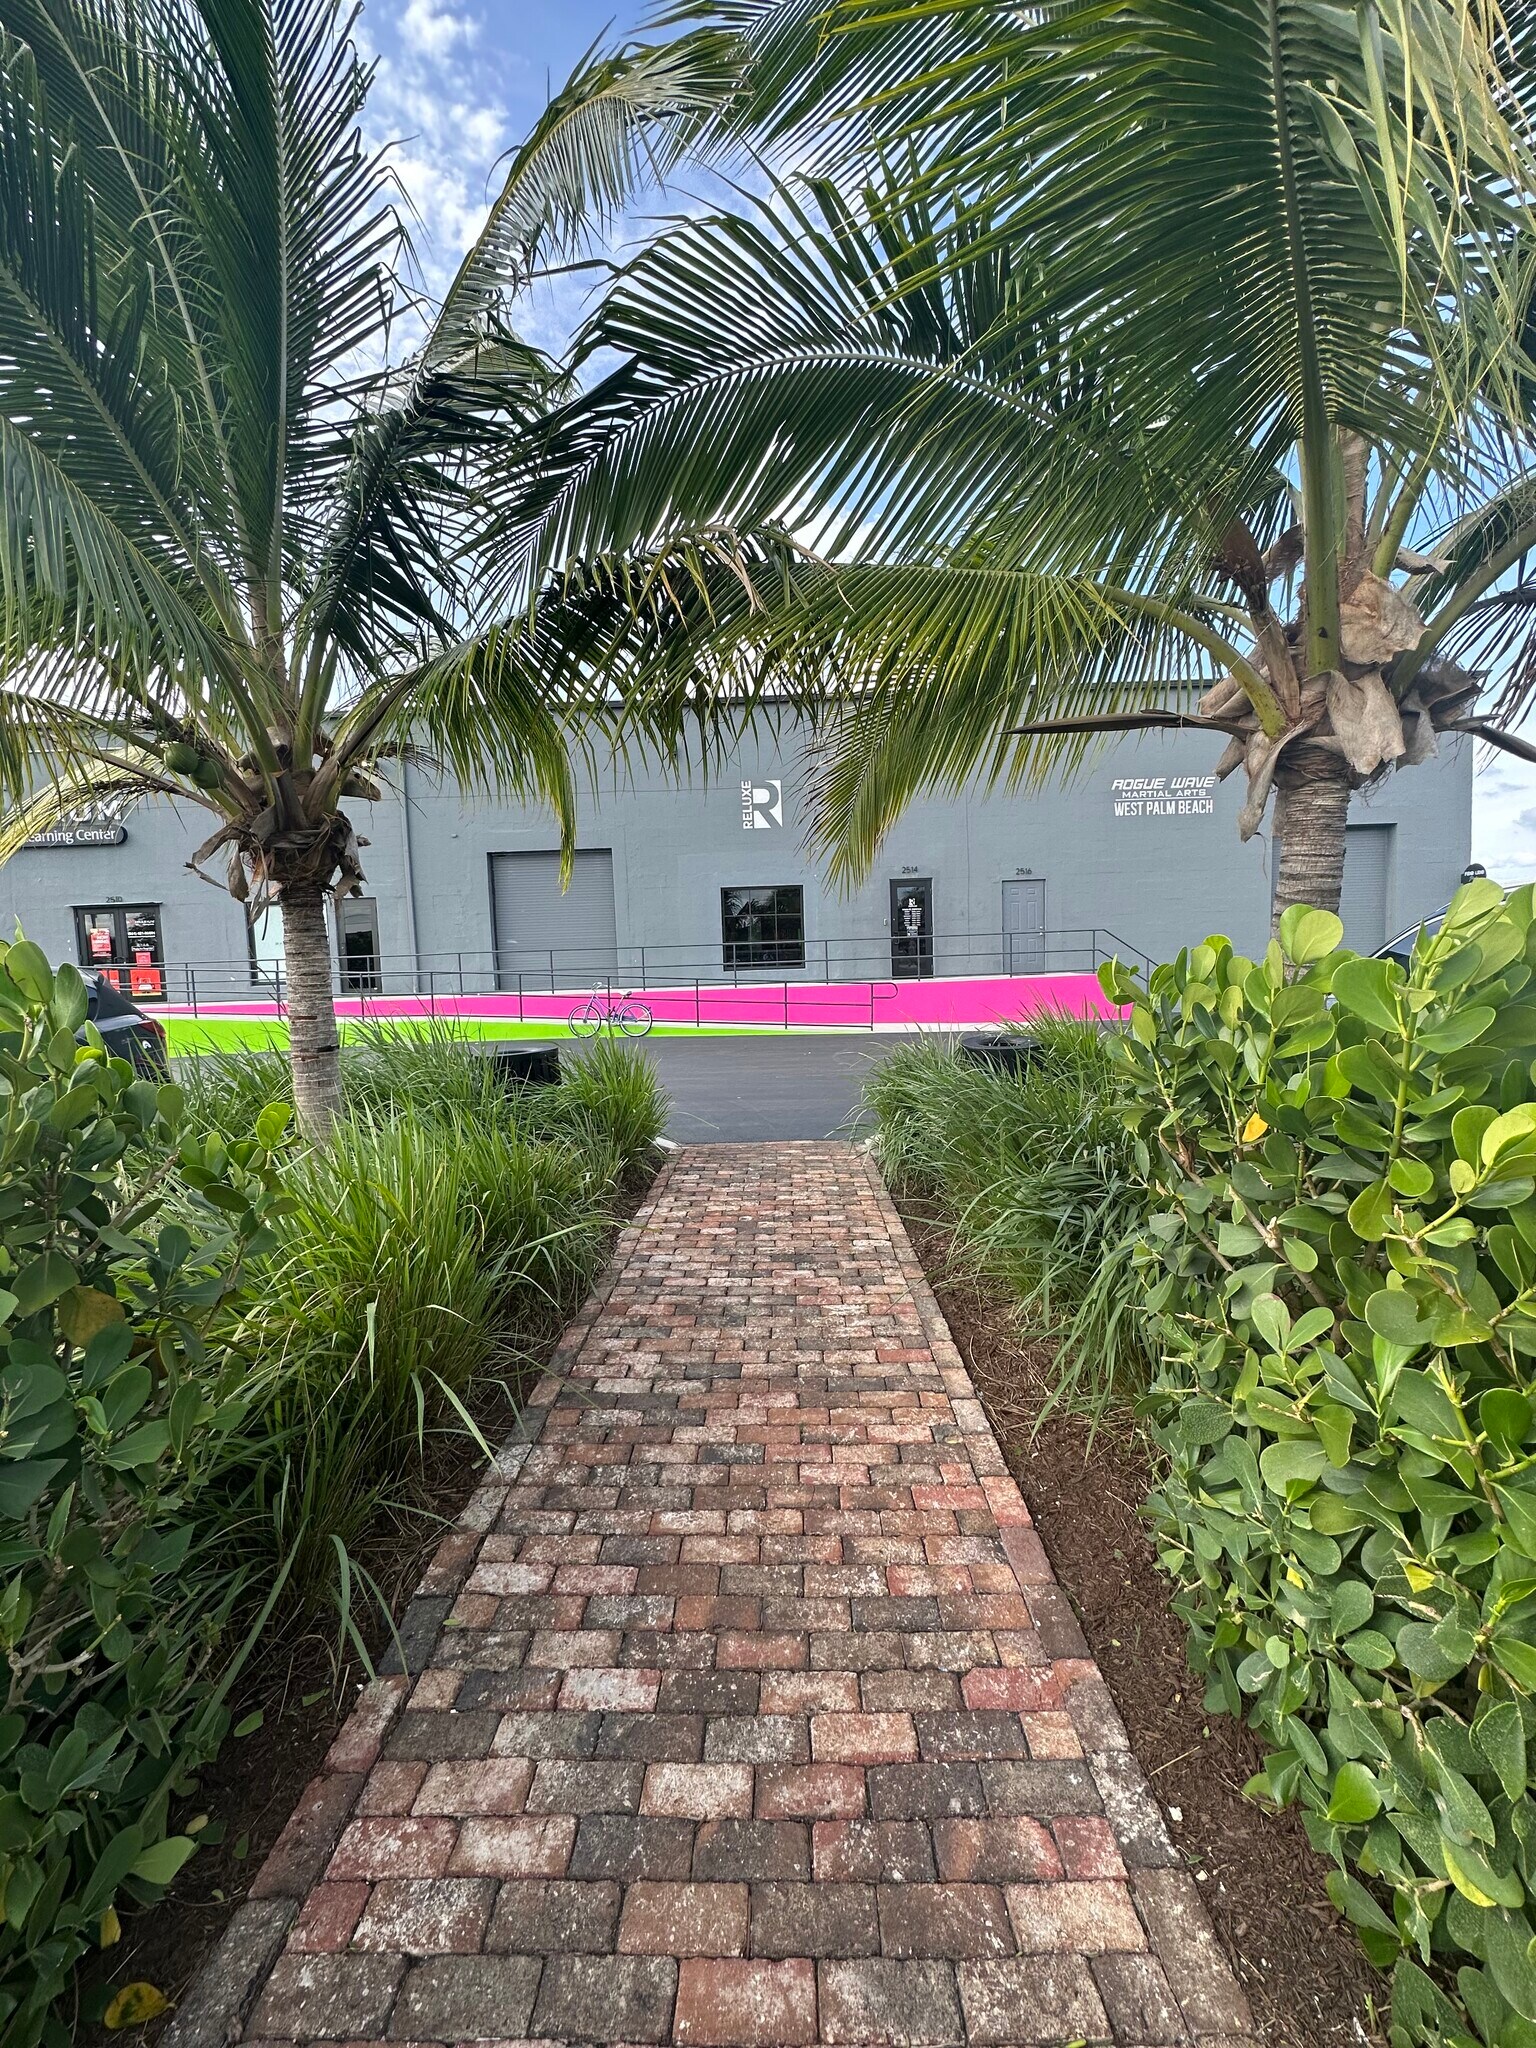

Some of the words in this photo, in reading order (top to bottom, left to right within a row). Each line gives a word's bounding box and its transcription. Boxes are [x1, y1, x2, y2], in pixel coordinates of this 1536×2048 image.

[1111, 778, 1167, 791] ROGUE
[1170, 776, 1216, 789] WAVE
[1122, 789, 1172, 799] MARTIAL
[1176, 788, 1207, 797] ARTS
[741, 780, 754, 830] RELUXE
[1114, 801, 1144, 817] WEST
[1146, 800, 1176, 816] PALM
[1178, 799, 1214, 815] BEACH
[26, 829, 75, 845] earning
[75, 828, 116, 841] Center
[901, 866, 919, 874] 2514
[1015, 868, 1032, 876] 2516
